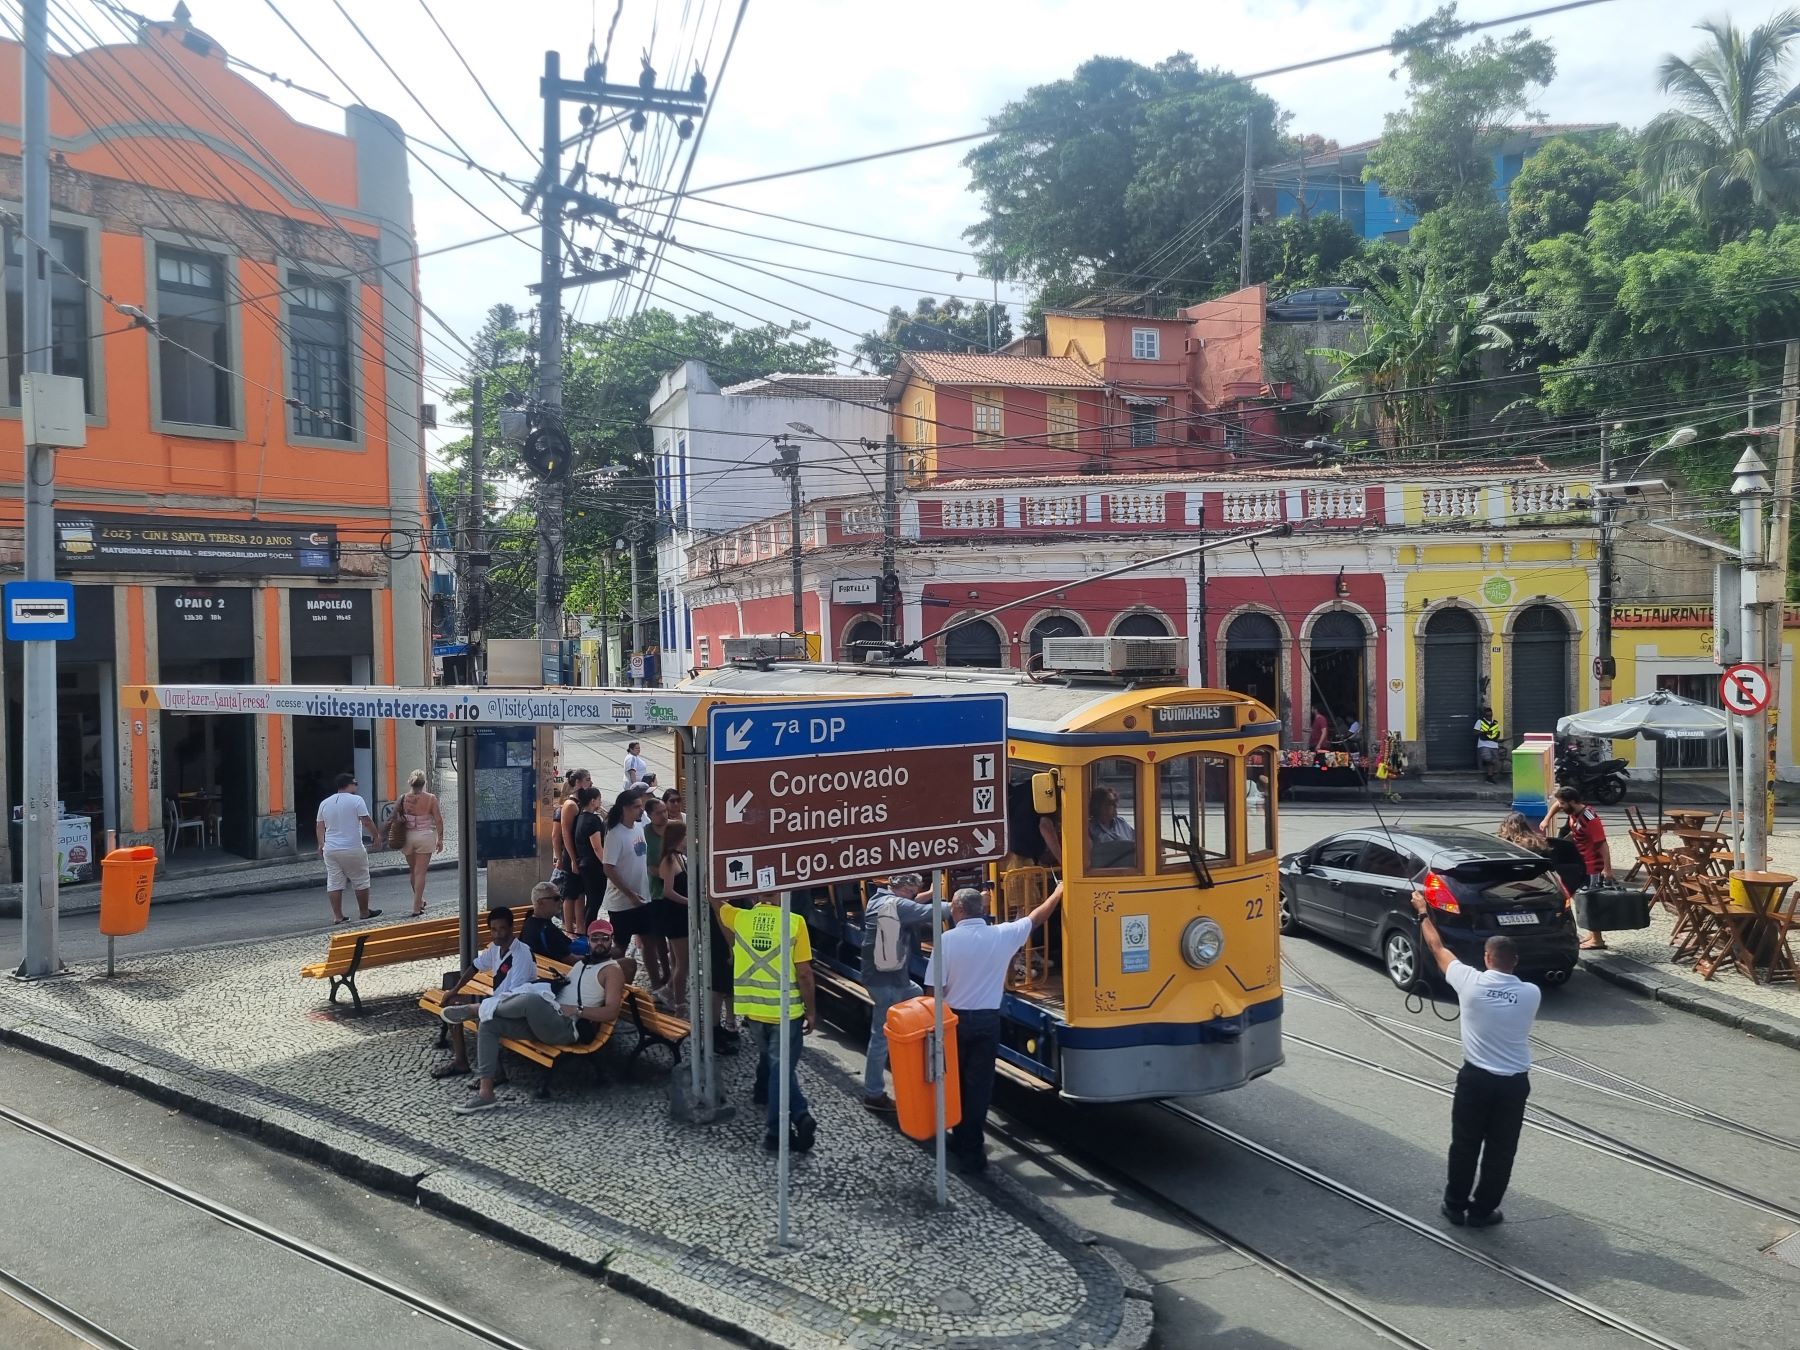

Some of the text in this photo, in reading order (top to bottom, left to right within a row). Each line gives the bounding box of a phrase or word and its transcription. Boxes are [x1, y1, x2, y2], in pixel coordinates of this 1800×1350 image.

[101, 528, 132, 540] 2023
[142, 530, 169, 541] CINE
[171, 532, 207, 543] SANTA
[209, 534, 248, 544] TERESA
[250, 536, 263, 545] 20
[265, 536, 293, 546] ANOS
[101, 547, 153, 555] MATURIDADE
[154, 549, 192, 557] CULTURAL
[198, 550, 268, 559] RESPONSABILIDADE
[268, 552, 294, 560] SOCIAL
[217, 598, 225, 609] 2
[187, 689, 210, 709] Fazer
[276, 699, 304, 709] acesse:
[306, 695, 480, 721] visitesantateresa.rio
[1736, 676, 1754, 705] E
[771, 716, 846, 746] 7ª DP
[768, 765, 910, 798] Corcovado
[768, 802, 889, 835] Paineiras
[780, 835, 960, 882] Lgo. das Neves
[1245, 897, 1263, 921] 22
